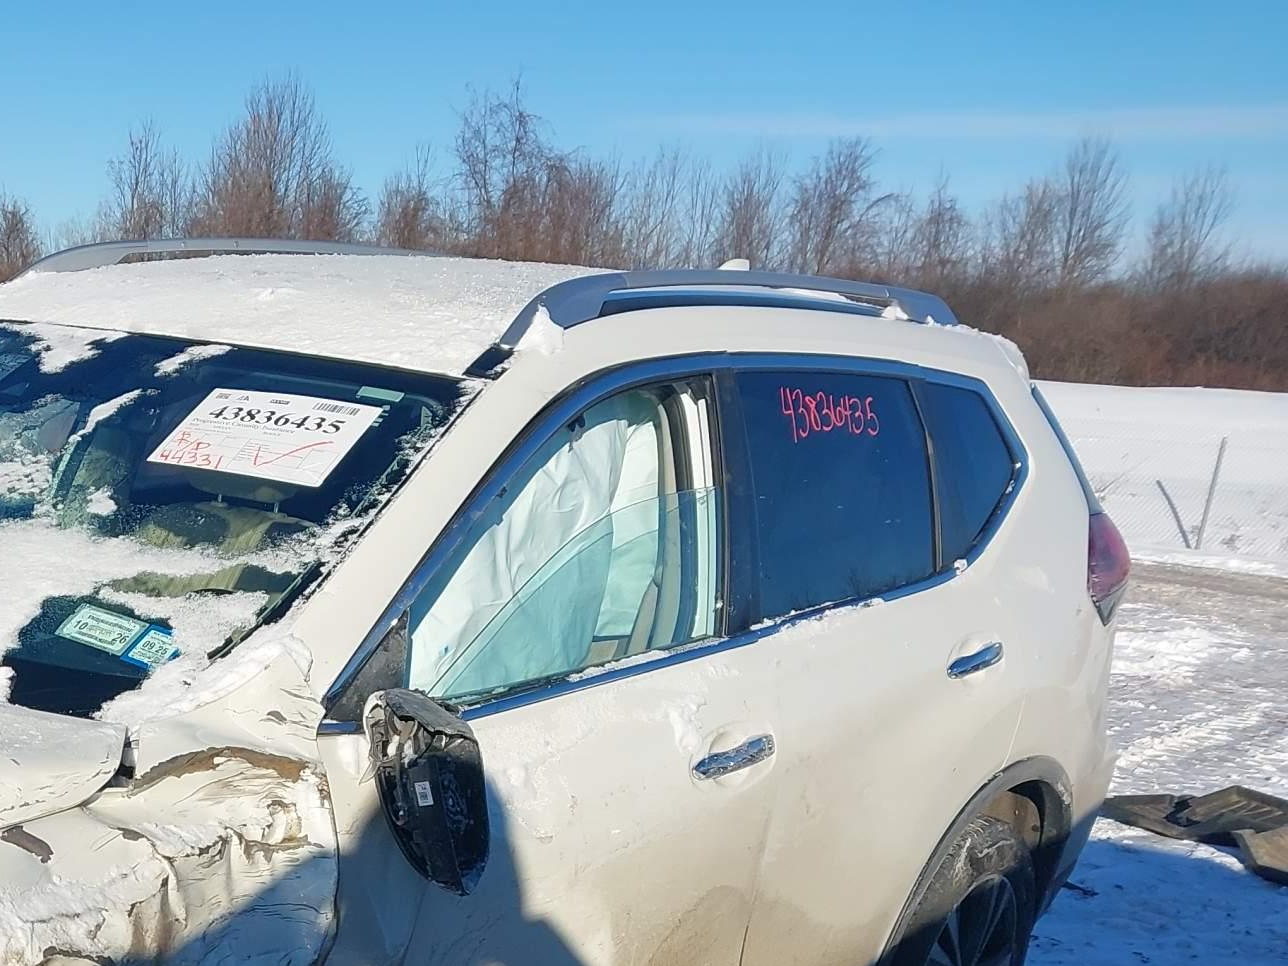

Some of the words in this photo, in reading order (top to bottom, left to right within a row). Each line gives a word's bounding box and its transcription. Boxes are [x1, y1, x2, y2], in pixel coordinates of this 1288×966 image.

[209, 405, 346, 434] 43836435
[780, 386, 880, 443] 43836435
[160, 450, 223, 469] 44331
[73, 619, 88, 630] 10
[111, 632, 129, 644] 26
[142, 640, 155, 650] 09
[155, 646, 168, 655] 25
